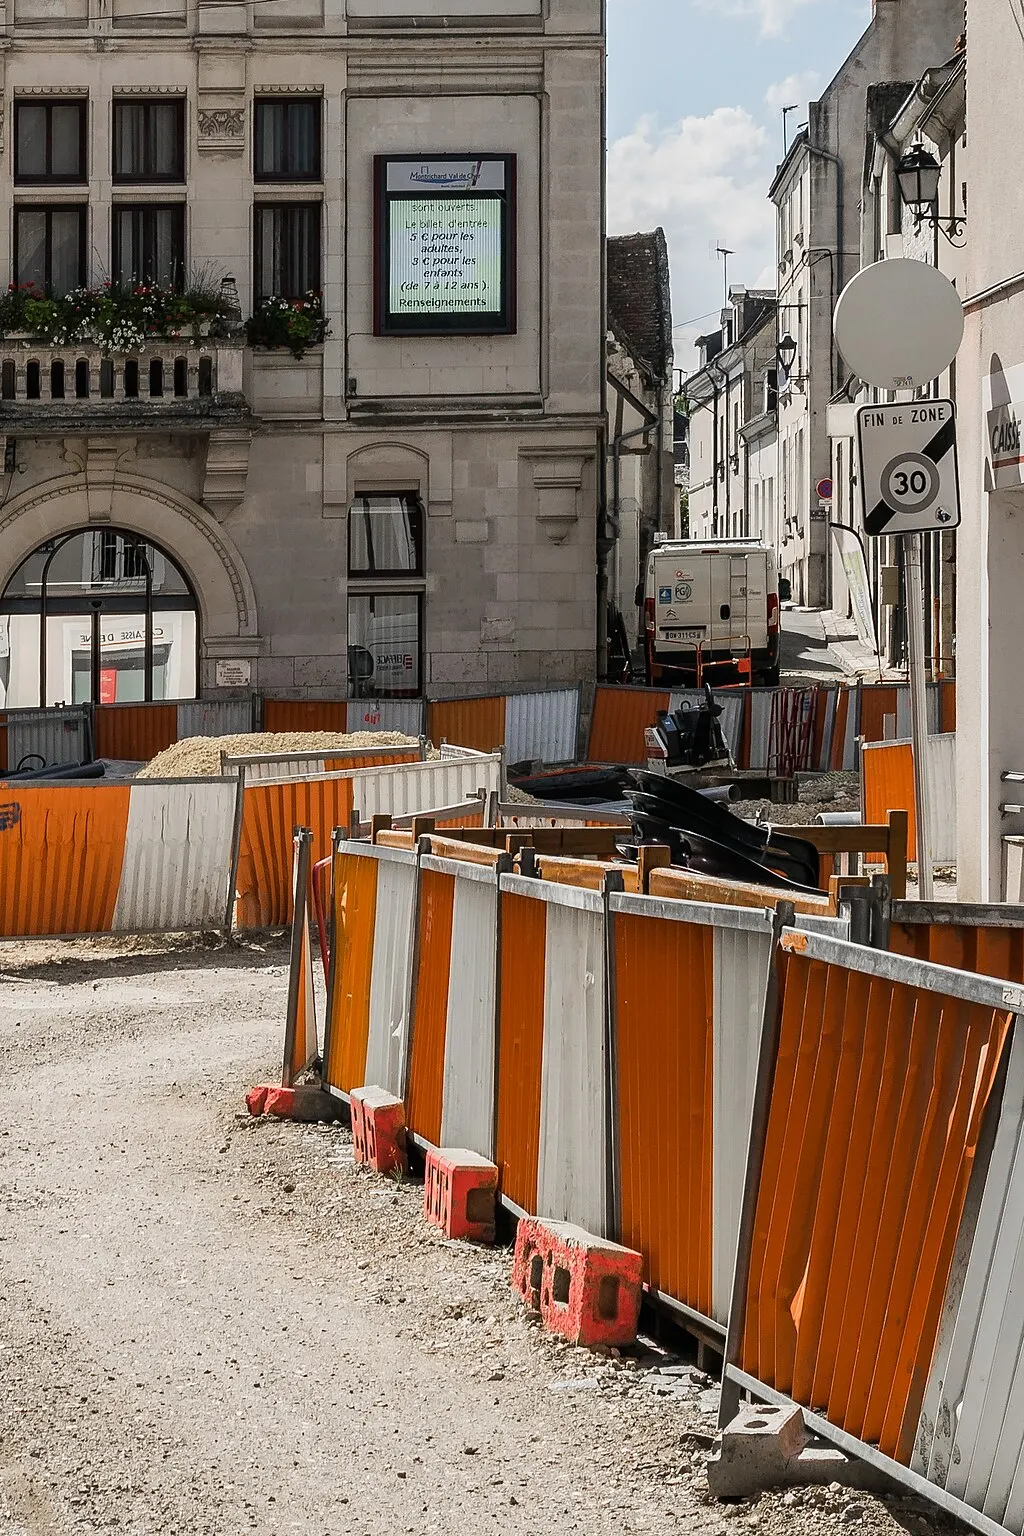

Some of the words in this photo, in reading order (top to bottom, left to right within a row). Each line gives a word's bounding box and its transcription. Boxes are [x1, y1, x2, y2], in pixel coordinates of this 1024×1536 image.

[412, 204, 434, 212] sont
[438, 204, 478, 212] ouverts.
[405, 221, 417, 229] Le
[419, 220, 443, 229] billet
[448, 219, 488, 228] d'entrée
[410, 233, 417, 242] 5
[431, 232, 458, 242] pour
[460, 232, 475, 241] les
[421, 244, 463, 254] adultes,
[412, 257, 419, 265] 3
[432, 257, 459, 266] pour
[462, 256, 476, 265] les
[423, 268, 463, 277] enfants
[401, 281, 419, 292] (de
[424, 281, 430, 290] 7
[433, 281, 440, 290] à
[445, 281, 458, 290] 12
[460, 281, 479, 290] ans
[399, 298, 487, 308] Renseignements
[863, 413, 884, 428] FIN
[892, 415, 903, 425] DE
[911, 407, 945, 423] ZONE
[893, 470, 927, 496] 30
